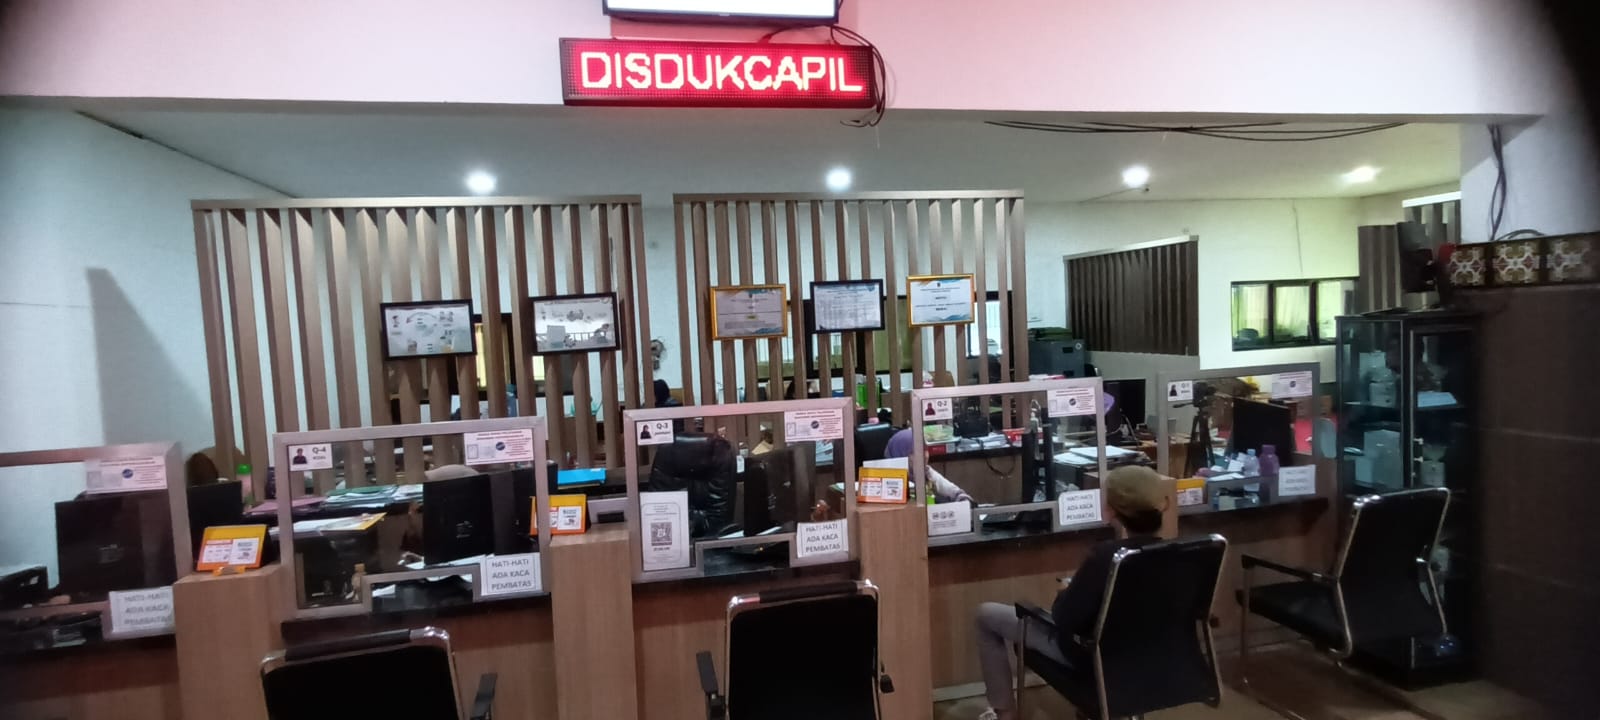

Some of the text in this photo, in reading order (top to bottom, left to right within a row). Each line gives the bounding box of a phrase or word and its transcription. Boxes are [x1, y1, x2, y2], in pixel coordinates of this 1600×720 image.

[580, 52, 863, 92] DISDUKCAPIL
[312, 446, 326, 454] Q-4
[1066, 493, 1094, 501] HATI-HATI
[1066, 512, 1096, 520] PEMBATAS
[806, 523, 838, 532] HATI-HATI
[822, 533, 839, 541] KACA
[806, 544, 841, 552] PEMBATAS
[491, 558, 529, 567] HATI-HATI
[492, 569, 530, 579] ADA KACA
[491, 580, 532, 590] PEMBATAS
